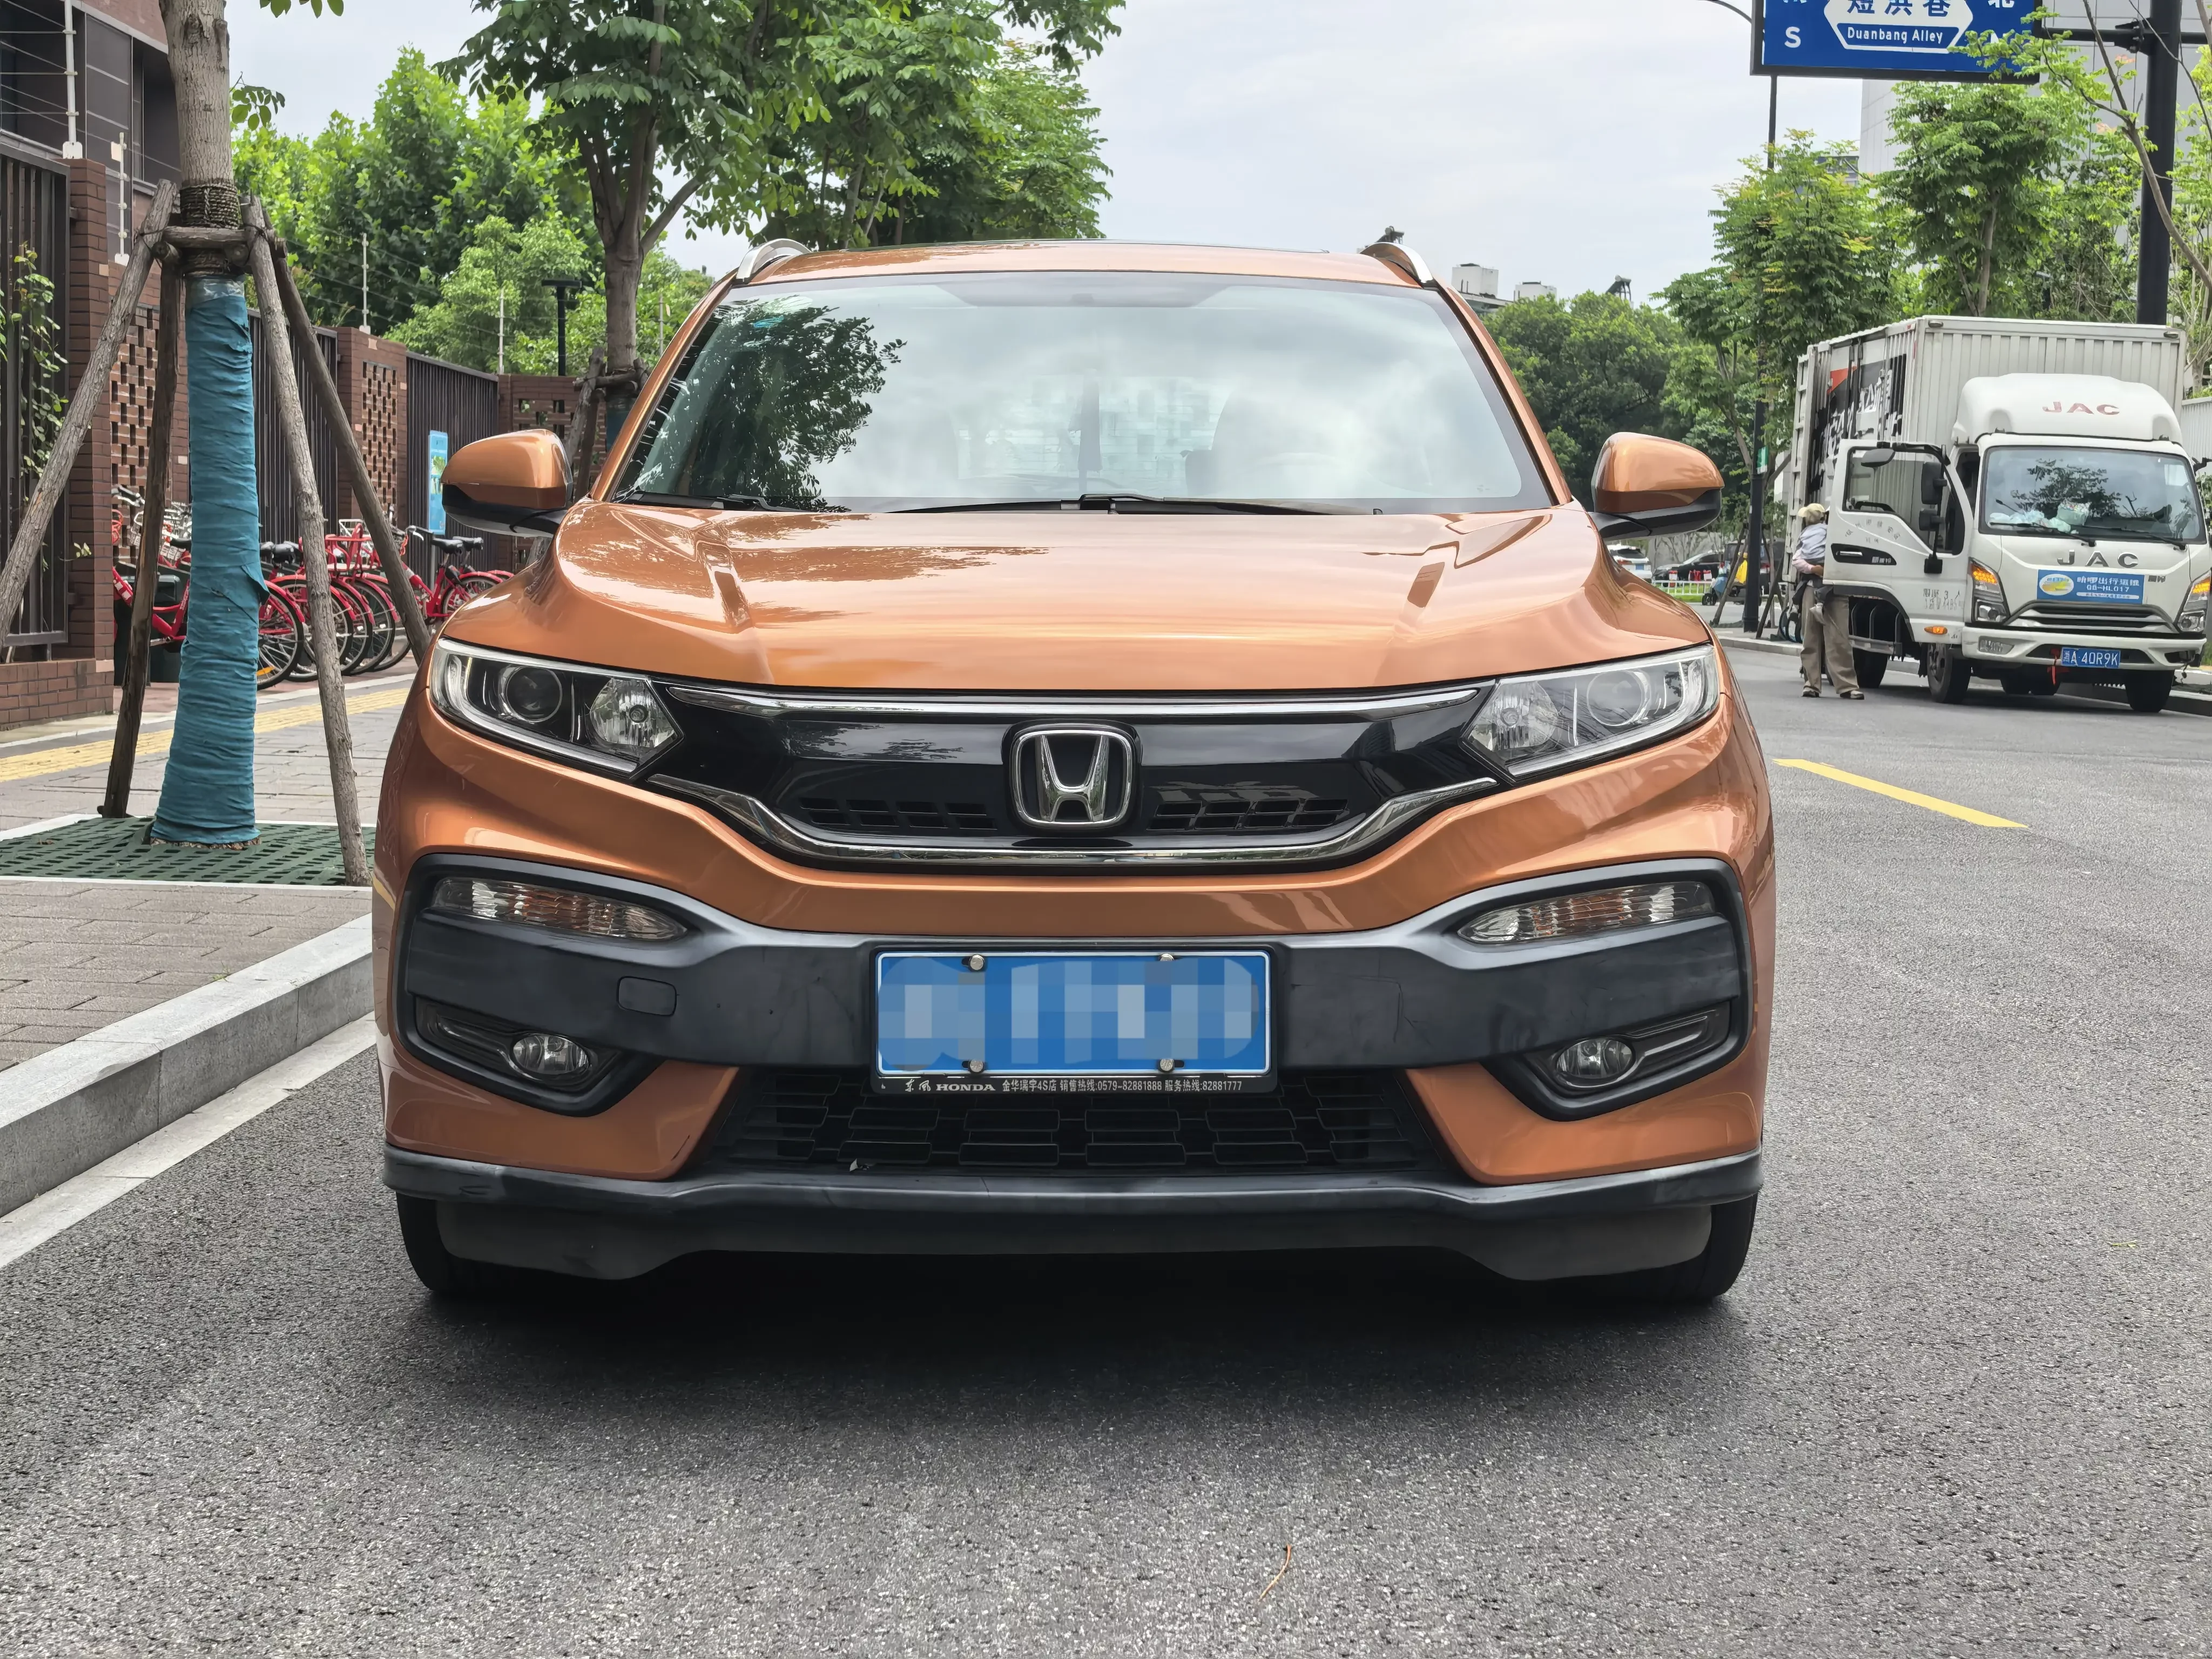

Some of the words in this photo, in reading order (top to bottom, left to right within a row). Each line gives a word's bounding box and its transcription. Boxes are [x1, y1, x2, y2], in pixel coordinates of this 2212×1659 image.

[1784, 26, 1801, 48] S
[1847, 27, 1907, 44] Duanbang
[1912, 29, 1943, 43] Alley
[2042, 401, 2120, 415] JAC
[2057, 549, 2139, 569] JAC
[936, 1083, 996, 1091] HONDA
